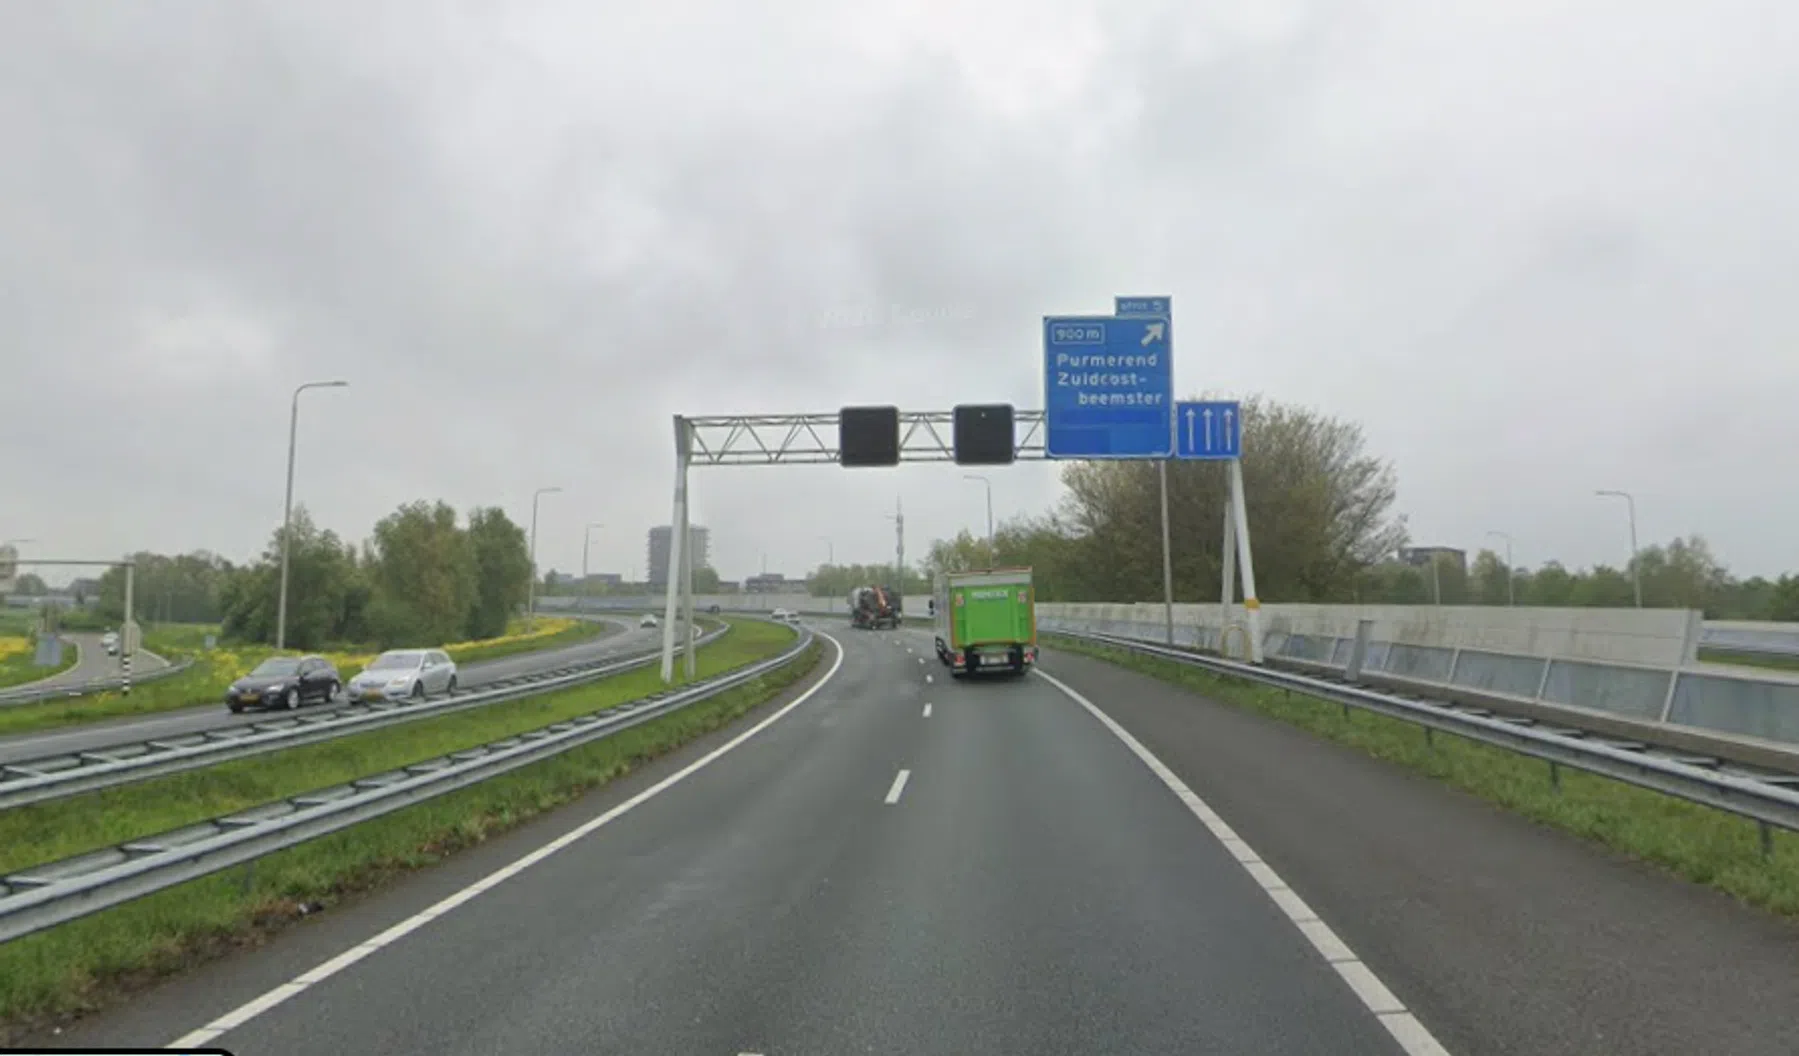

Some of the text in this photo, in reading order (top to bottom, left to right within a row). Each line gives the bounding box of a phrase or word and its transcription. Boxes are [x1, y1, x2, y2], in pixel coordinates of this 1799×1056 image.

[1056, 329, 1100, 340] 900 m
[1056, 353, 1158, 367] Purmerend
[1078, 391, 1162, 405] beemster
